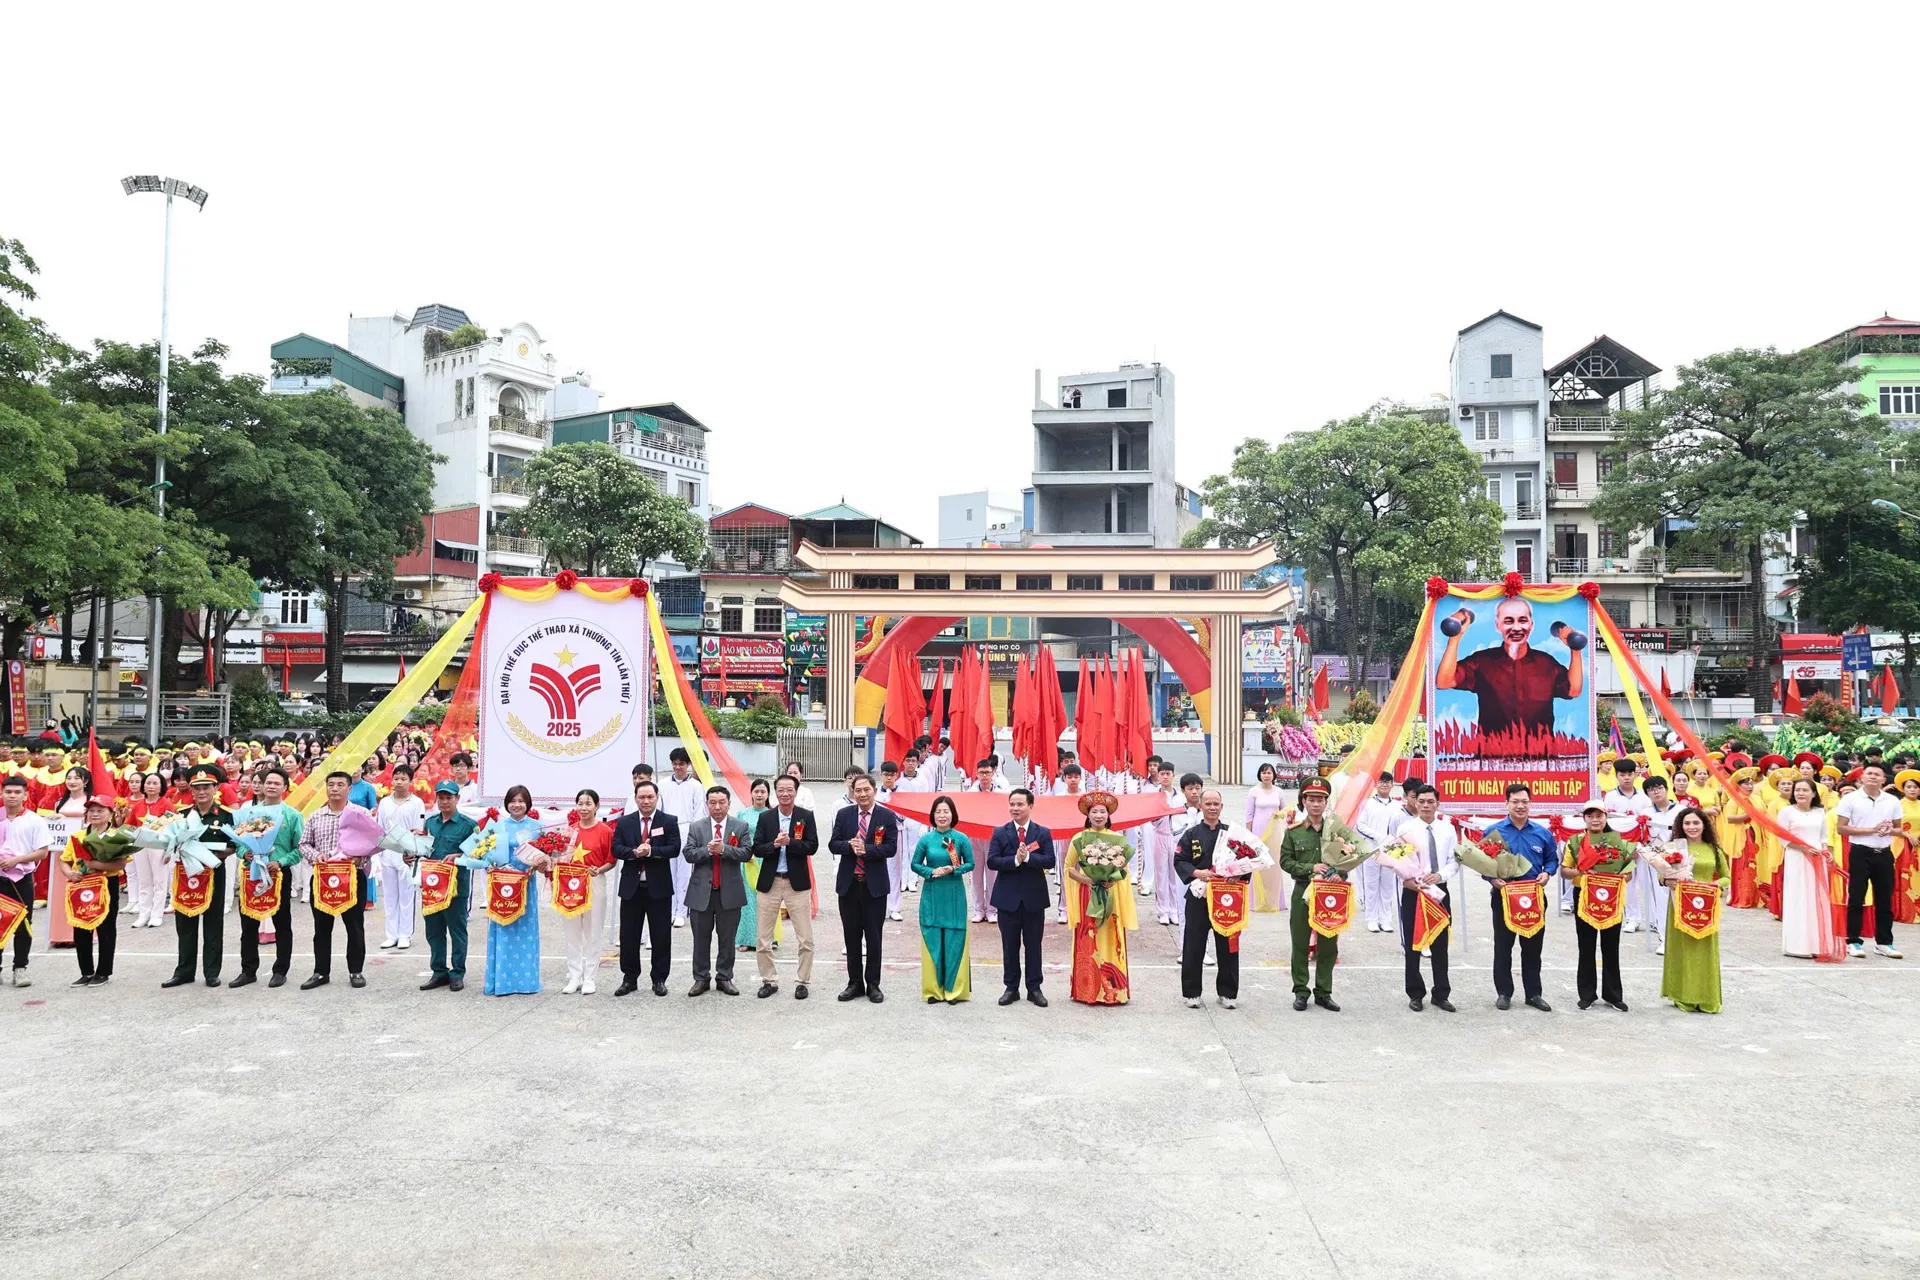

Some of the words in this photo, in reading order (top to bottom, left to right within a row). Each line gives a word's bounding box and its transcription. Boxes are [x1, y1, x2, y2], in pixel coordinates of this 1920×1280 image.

[513, 640, 529, 657] DỤC
[528, 626, 544, 643] THỂ
[544, 624, 566, 636] THAO
[569, 624, 580, 634] XÃ
[547, 722, 581, 737] 2025
[1459, 776, 1475, 795] TÔI
[1478, 776, 1505, 795] NGÀY
[1532, 777, 1560, 796] CŨNG
